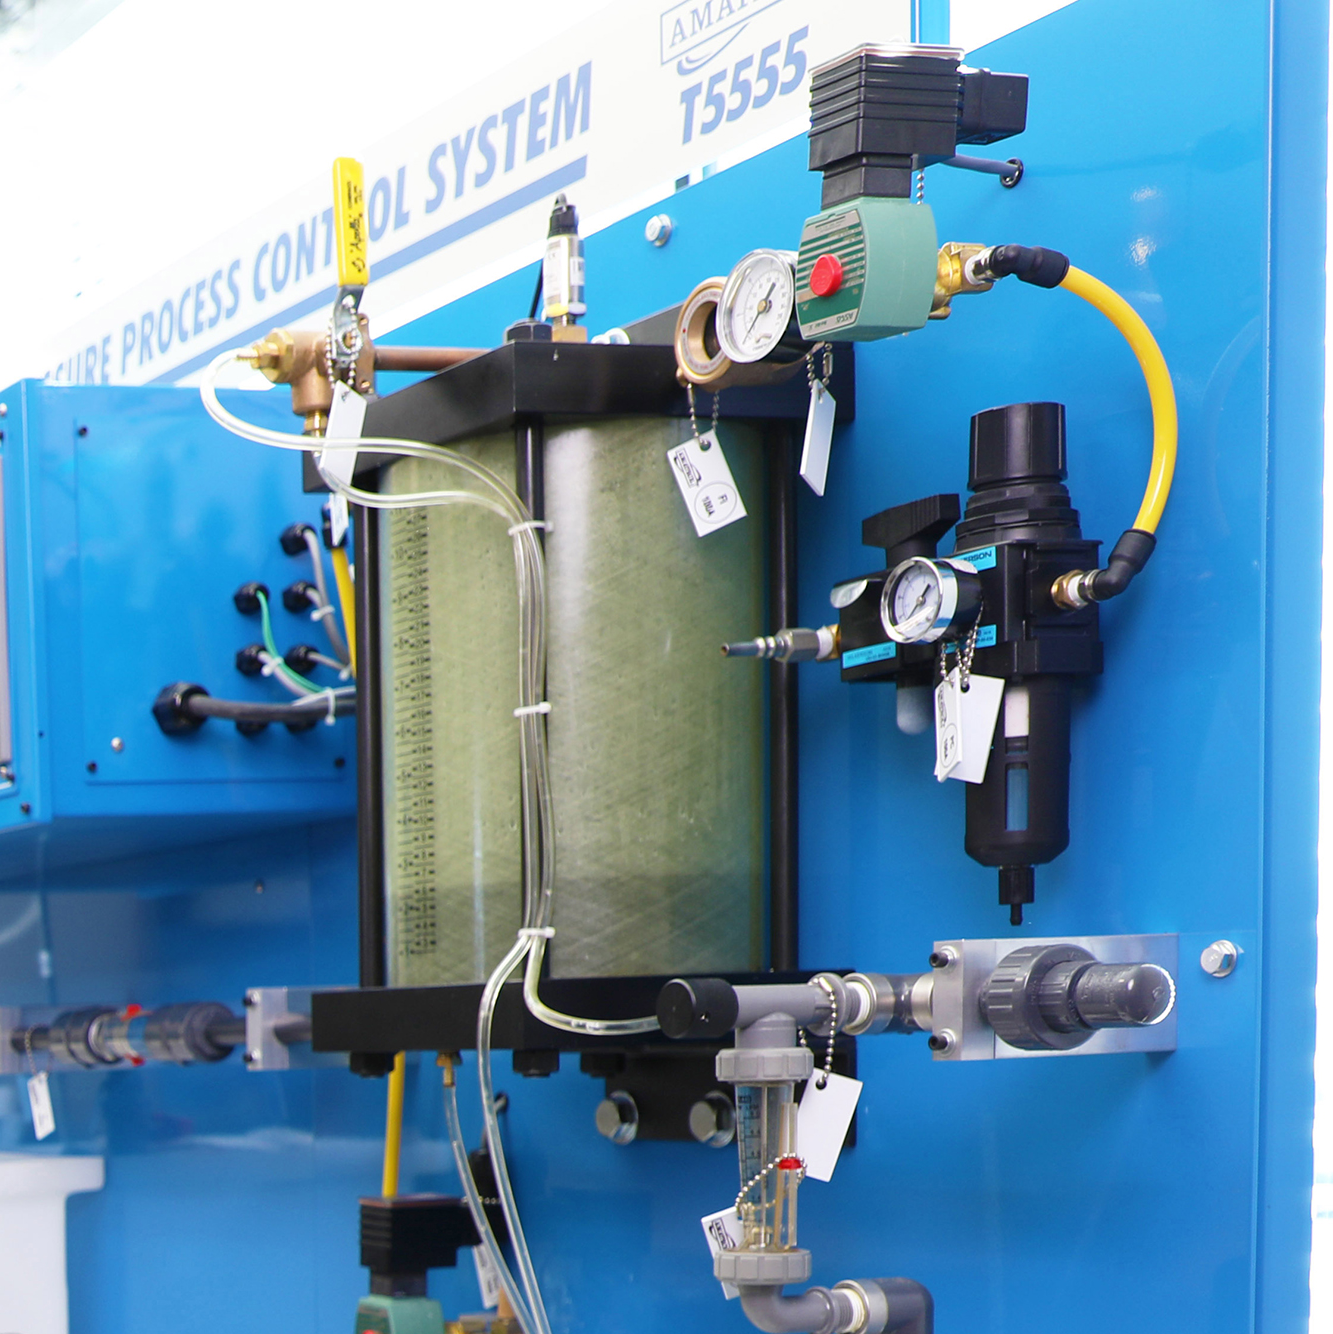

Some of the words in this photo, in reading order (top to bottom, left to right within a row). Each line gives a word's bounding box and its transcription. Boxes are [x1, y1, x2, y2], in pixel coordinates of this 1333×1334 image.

[680, 24, 810, 146] T5555
[121, 259, 240, 378] PROCESS
[253, 165, 412, 316] CONTOL
[424, 60, 593, 215] SYSTEM
